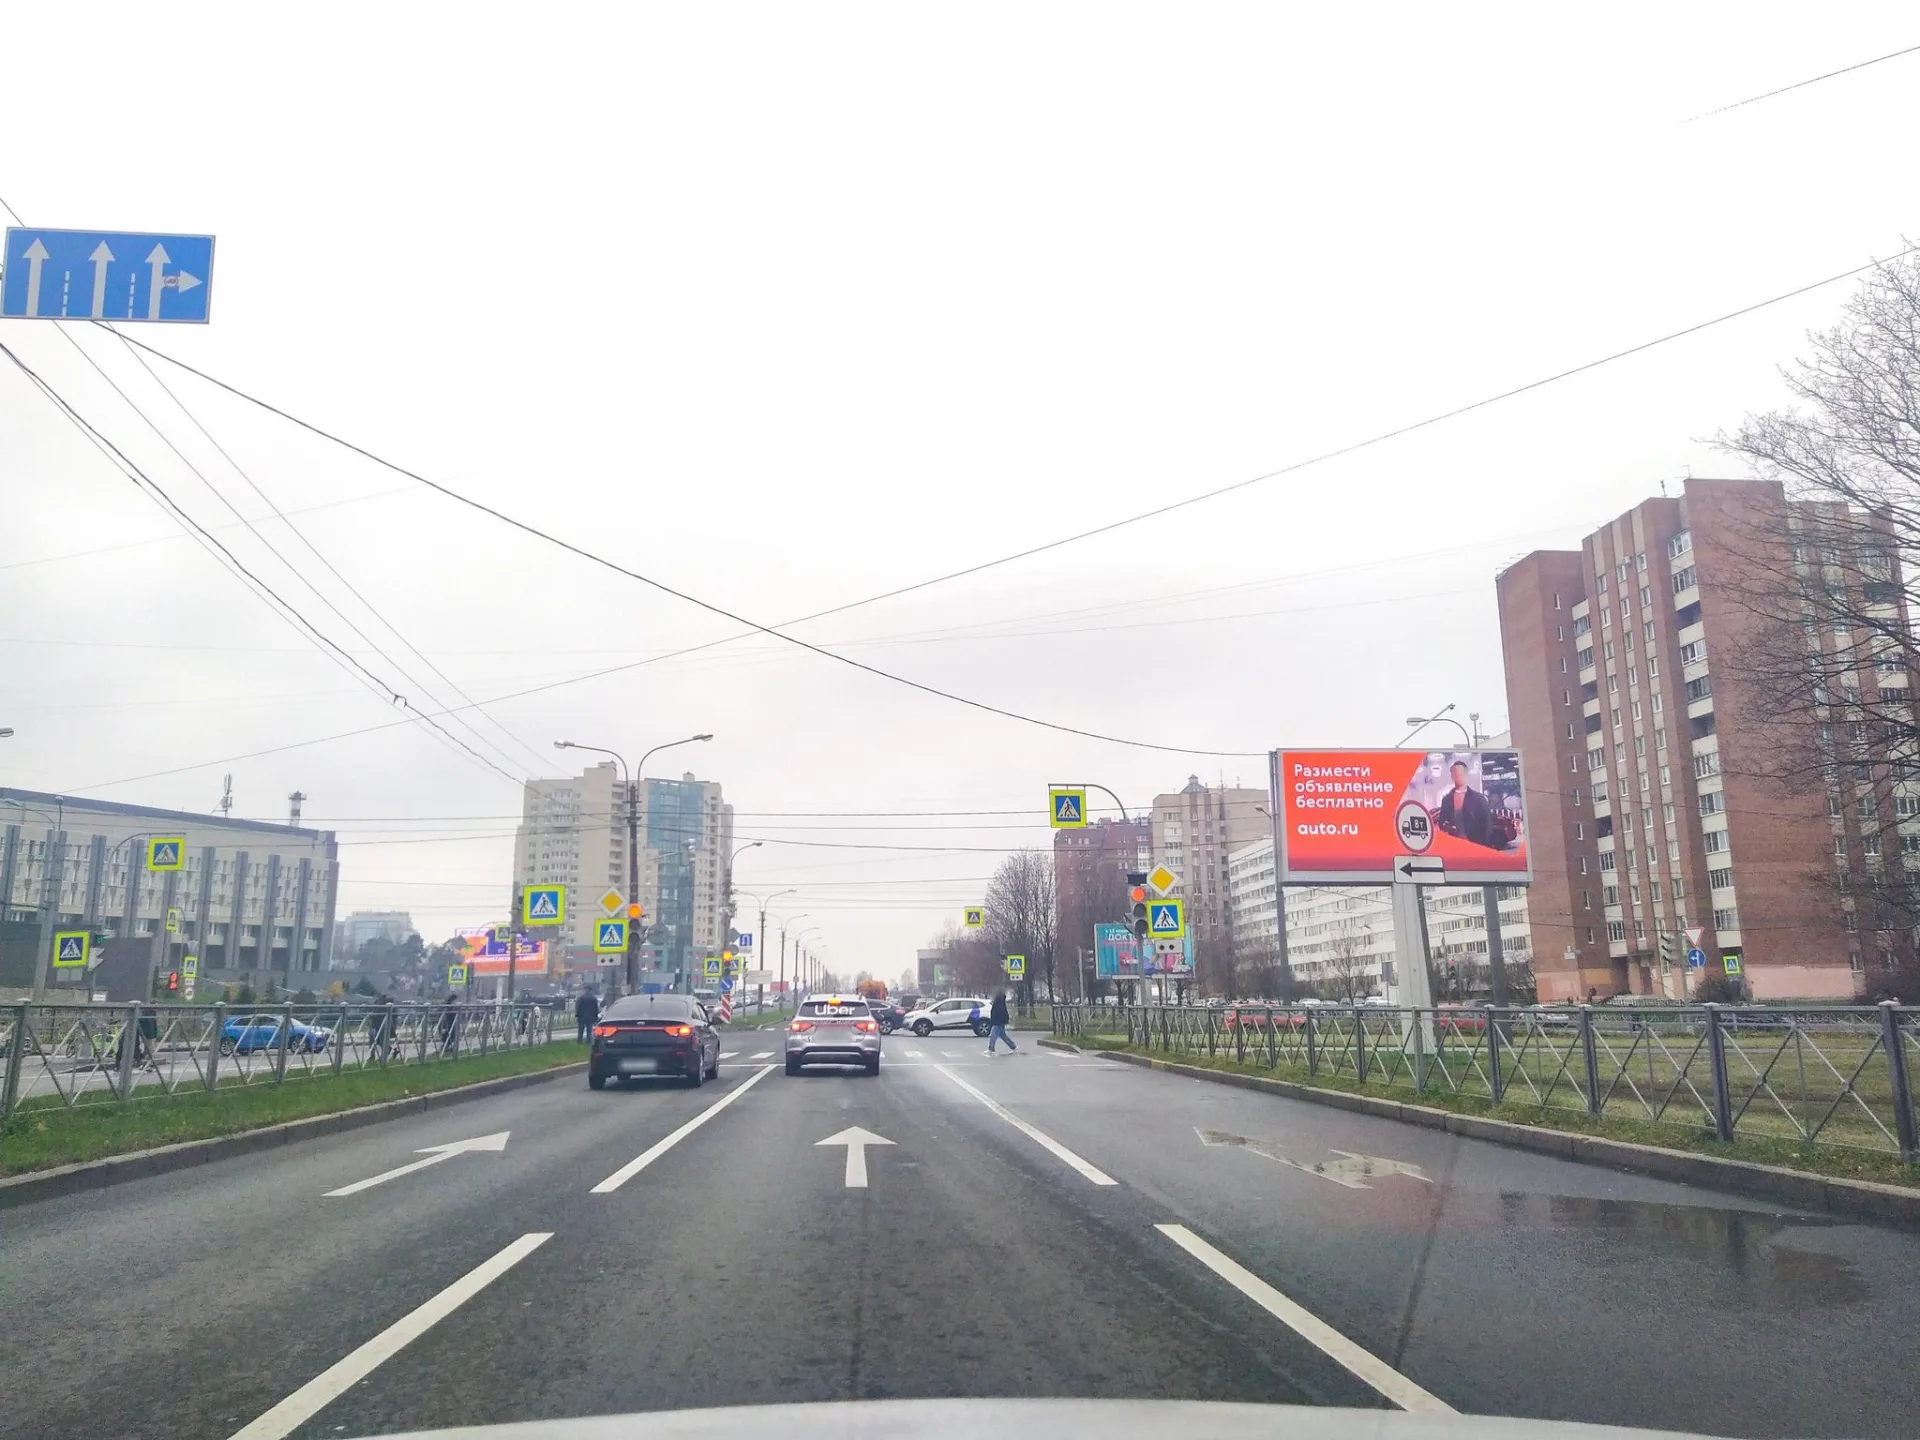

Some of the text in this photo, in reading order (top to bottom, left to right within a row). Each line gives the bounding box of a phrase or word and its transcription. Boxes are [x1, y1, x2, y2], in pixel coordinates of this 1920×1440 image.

[1294, 763, 1371, 777] Размести
[1295, 780, 1394, 793] объявление
[1296, 795, 1384, 808] бесплатно
[1297, 822, 1359, 835] auto.ru
[814, 1004, 856, 1016] Uber
